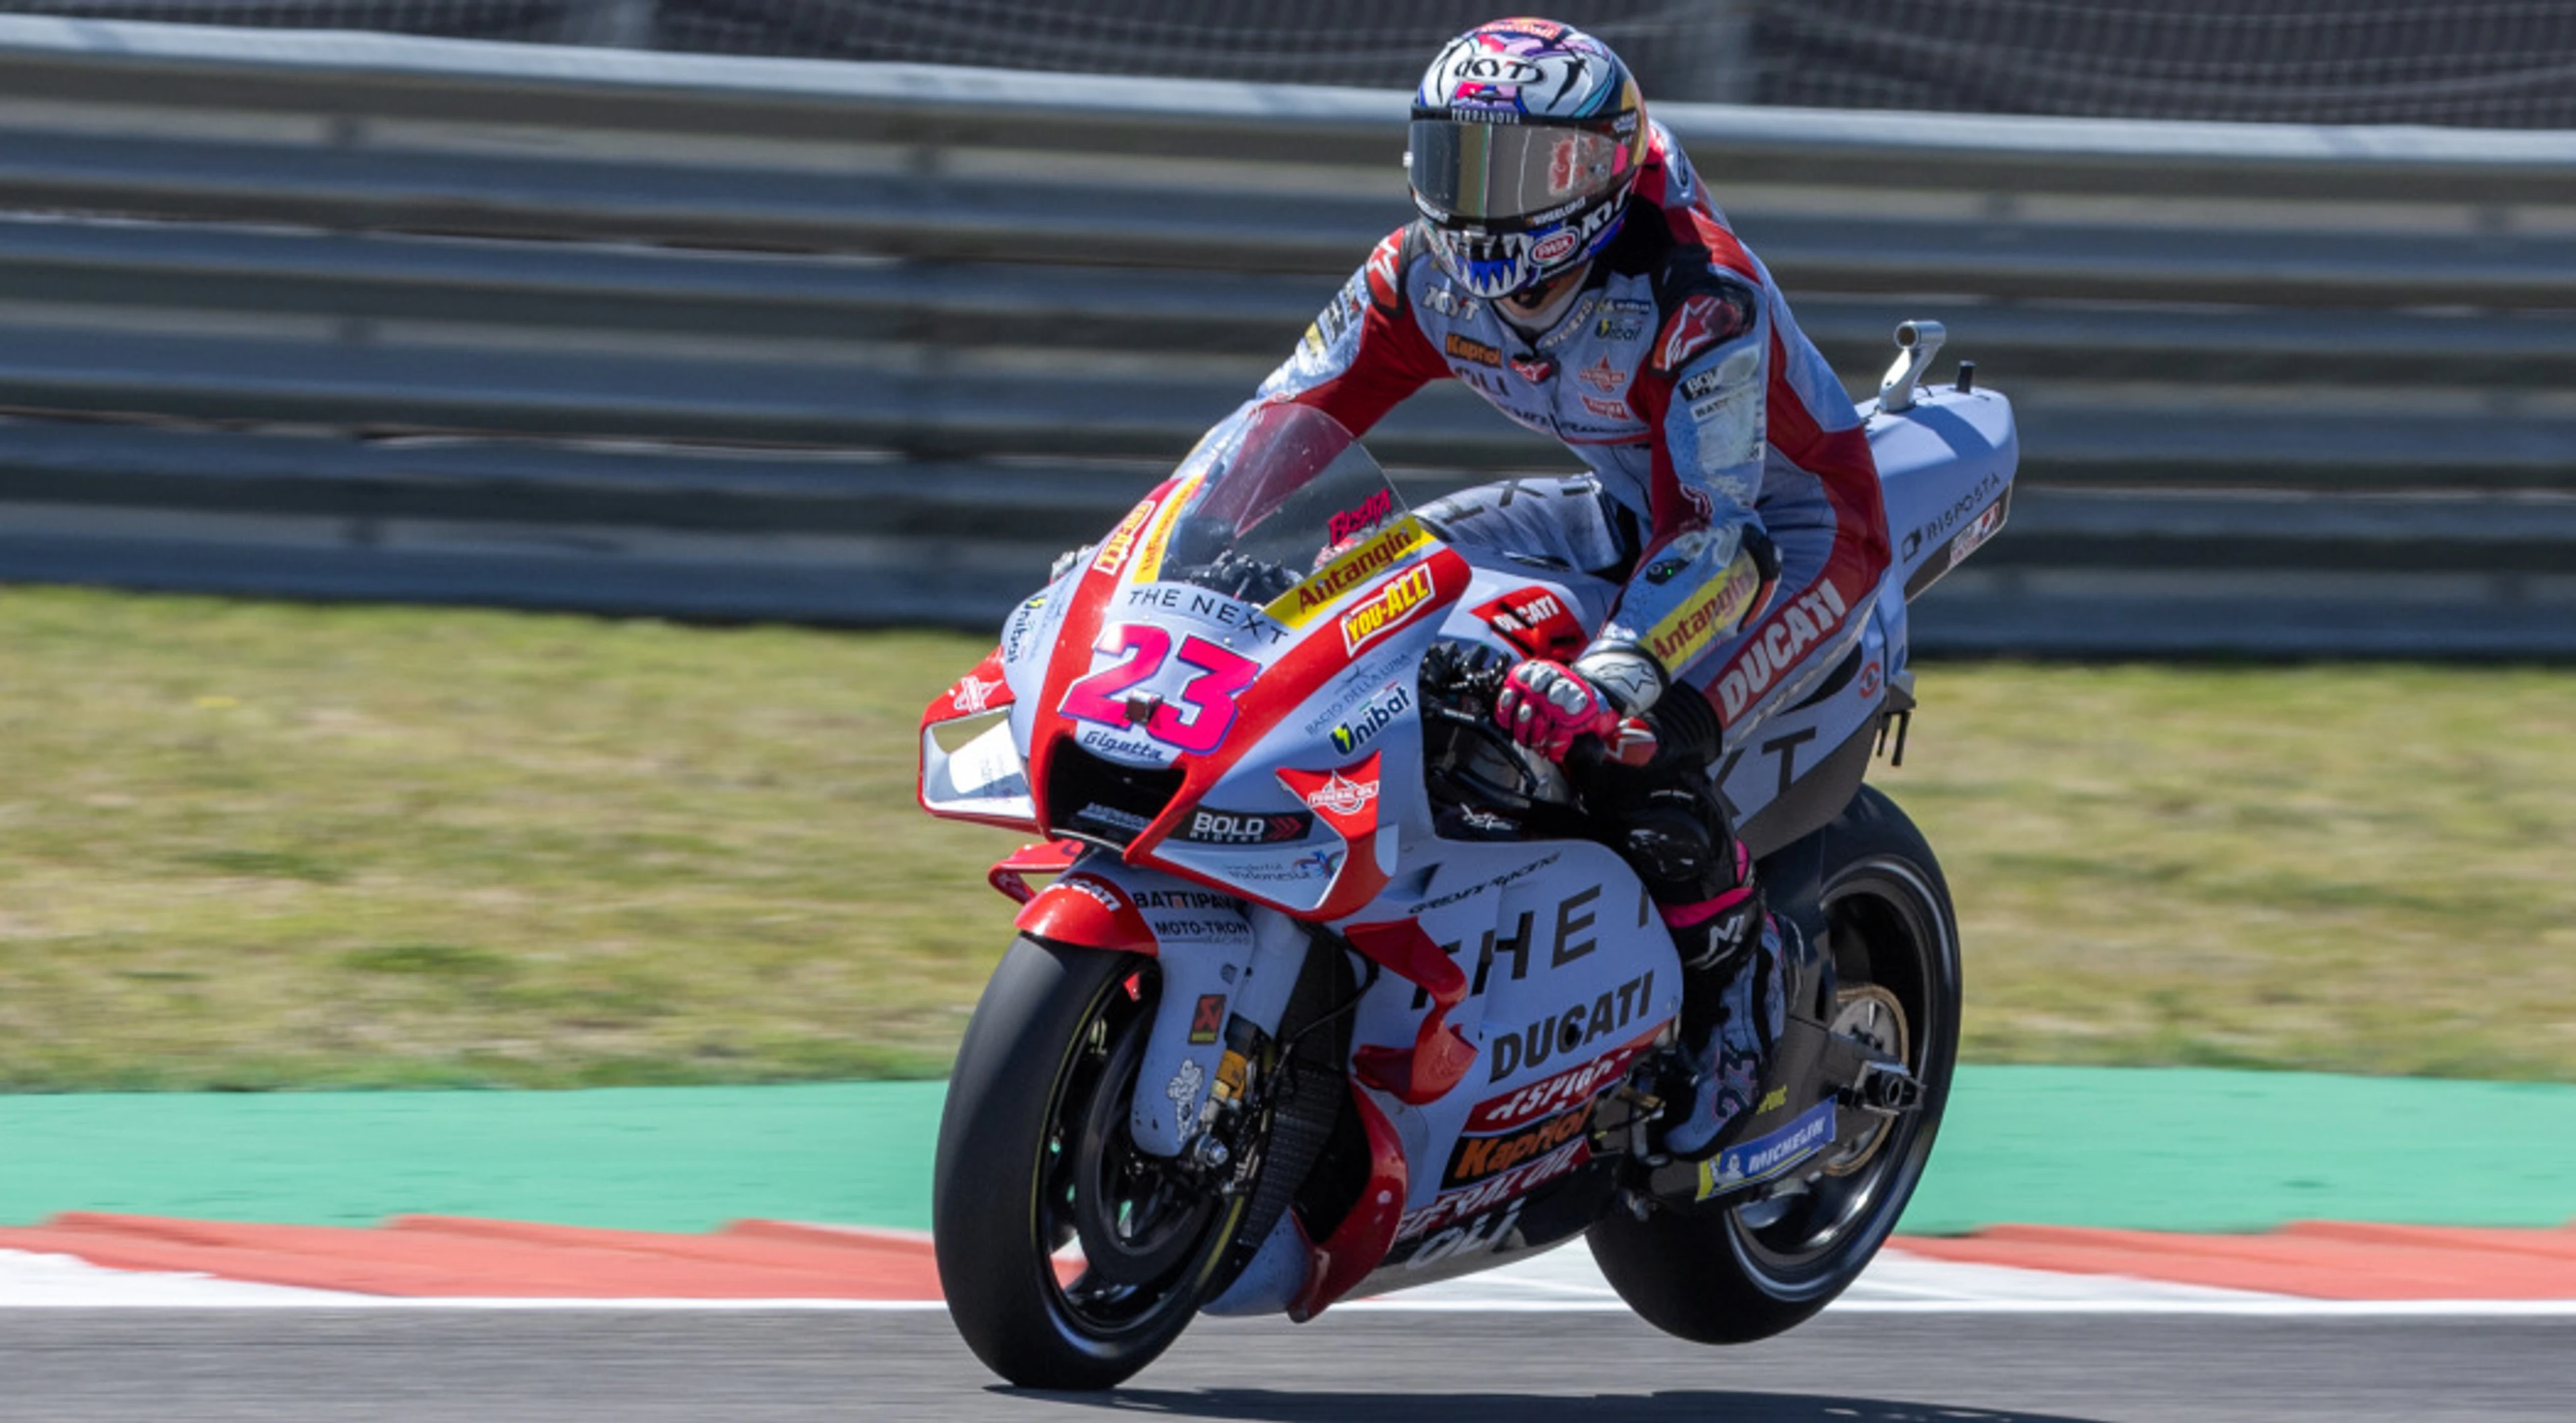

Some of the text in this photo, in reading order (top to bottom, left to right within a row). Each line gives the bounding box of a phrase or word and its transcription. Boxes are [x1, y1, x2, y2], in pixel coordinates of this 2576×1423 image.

[1926, 472, 2002, 541] RISPOSTA
[1297, 527, 1413, 613] Antangin
[1128, 588, 1289, 644] THE NEXT
[1347, 571, 1430, 641] YOU-ALL
[1652, 570, 1757, 661] Antangin
[1717, 578, 1847, 723] DUCATI
[1058, 623, 1263, 756] 23
[1328, 686, 1410, 755] Unibat
[1193, 811, 1265, 836] BOLD
[1154, 920, 1250, 936] MOTO-TRON
[1489, 970, 1655, 1085] DUCATI
[1748, 1116, 1826, 1173] MICHELIN
